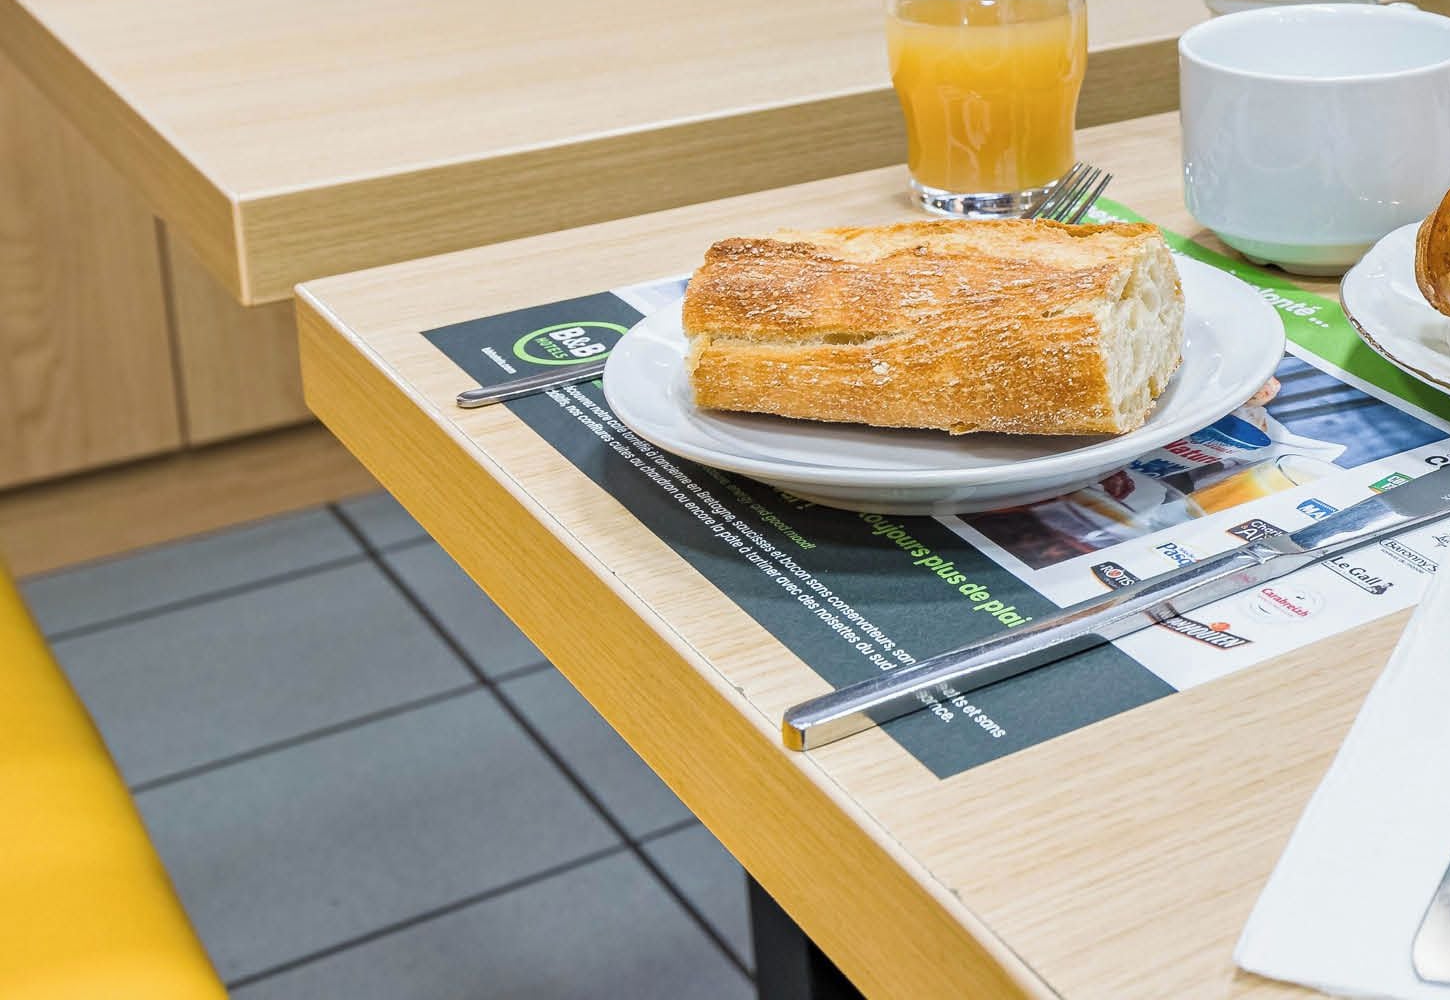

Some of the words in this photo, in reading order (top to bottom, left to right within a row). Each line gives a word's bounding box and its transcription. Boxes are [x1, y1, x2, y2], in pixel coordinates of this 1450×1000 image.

[535, 336, 570, 359] HOTELS
[549, 326, 607, 357] B&B
[565, 405, 582, 417] nos
[577, 414, 615, 443] confitures
[609, 439, 635, 460] cuites
[640, 465, 679, 494] chaudron
[673, 492, 689, 505] ou
[684, 499, 716, 526] encore
[591, 403, 613, 421] notre
[607, 416, 629, 434] café
[622, 429, 653, 455] torréfié
[652, 453, 693, 486] l'ancienne
[687, 482, 703, 493] en
[696, 490, 736, 524] Bretagne,
[732, 519, 776, 553] saucisses
[770, 549, 788, 561] et
[779, 556, 812, 582] bacon
[806, 575, 833, 599] sans
[827, 595, 896, 652] conservateurs,
[892, 648, 918, 667] san
[709, 522, 723, 533] la
[714, 530, 744, 549] pâte
[738, 545, 752, 555] à
[747, 551, 782, 579] tartiner
[912, 554, 967, 585] plus
[1330, 556, 1356, 569] Le
[1349, 567, 1382, 586] Gall
[775, 575, 802, 597] avec
[958, 582, 991, 602] de
[797, 593, 820, 611] des
[972, 600, 1033, 628] plai
[813, 607, 861, 645] noisettes
[854, 640, 875, 656] du
[869, 652, 898, 672] sud
[963, 704, 983, 719] et
[974, 713, 1006, 738] sans
